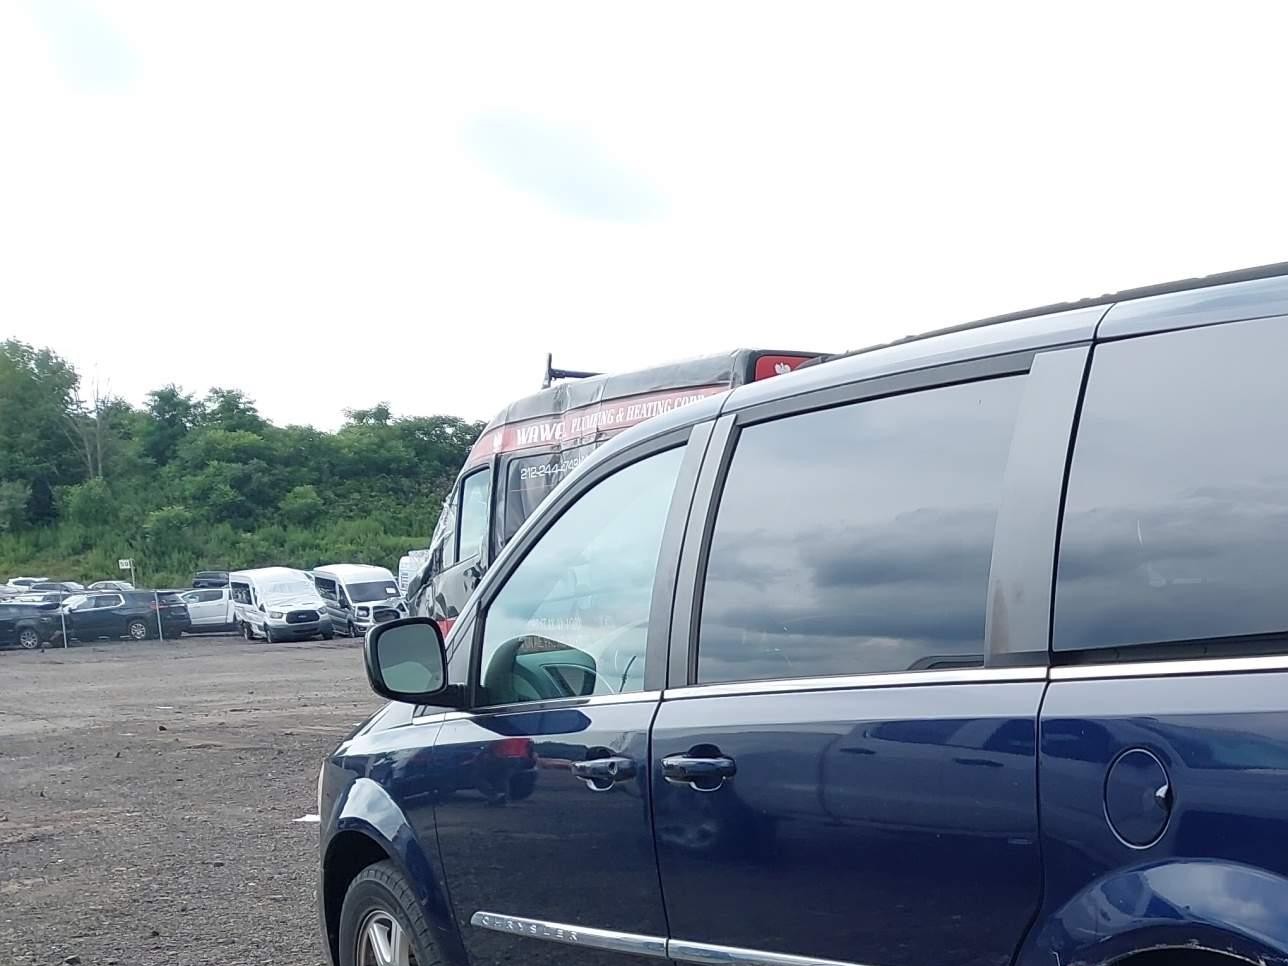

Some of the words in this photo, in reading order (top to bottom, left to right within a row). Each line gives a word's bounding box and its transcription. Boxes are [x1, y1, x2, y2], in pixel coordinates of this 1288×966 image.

[615, 407, 625, 423] &
[626, 398, 673, 420] HEATING
[481, 916, 578, 942] CHRYSLER
